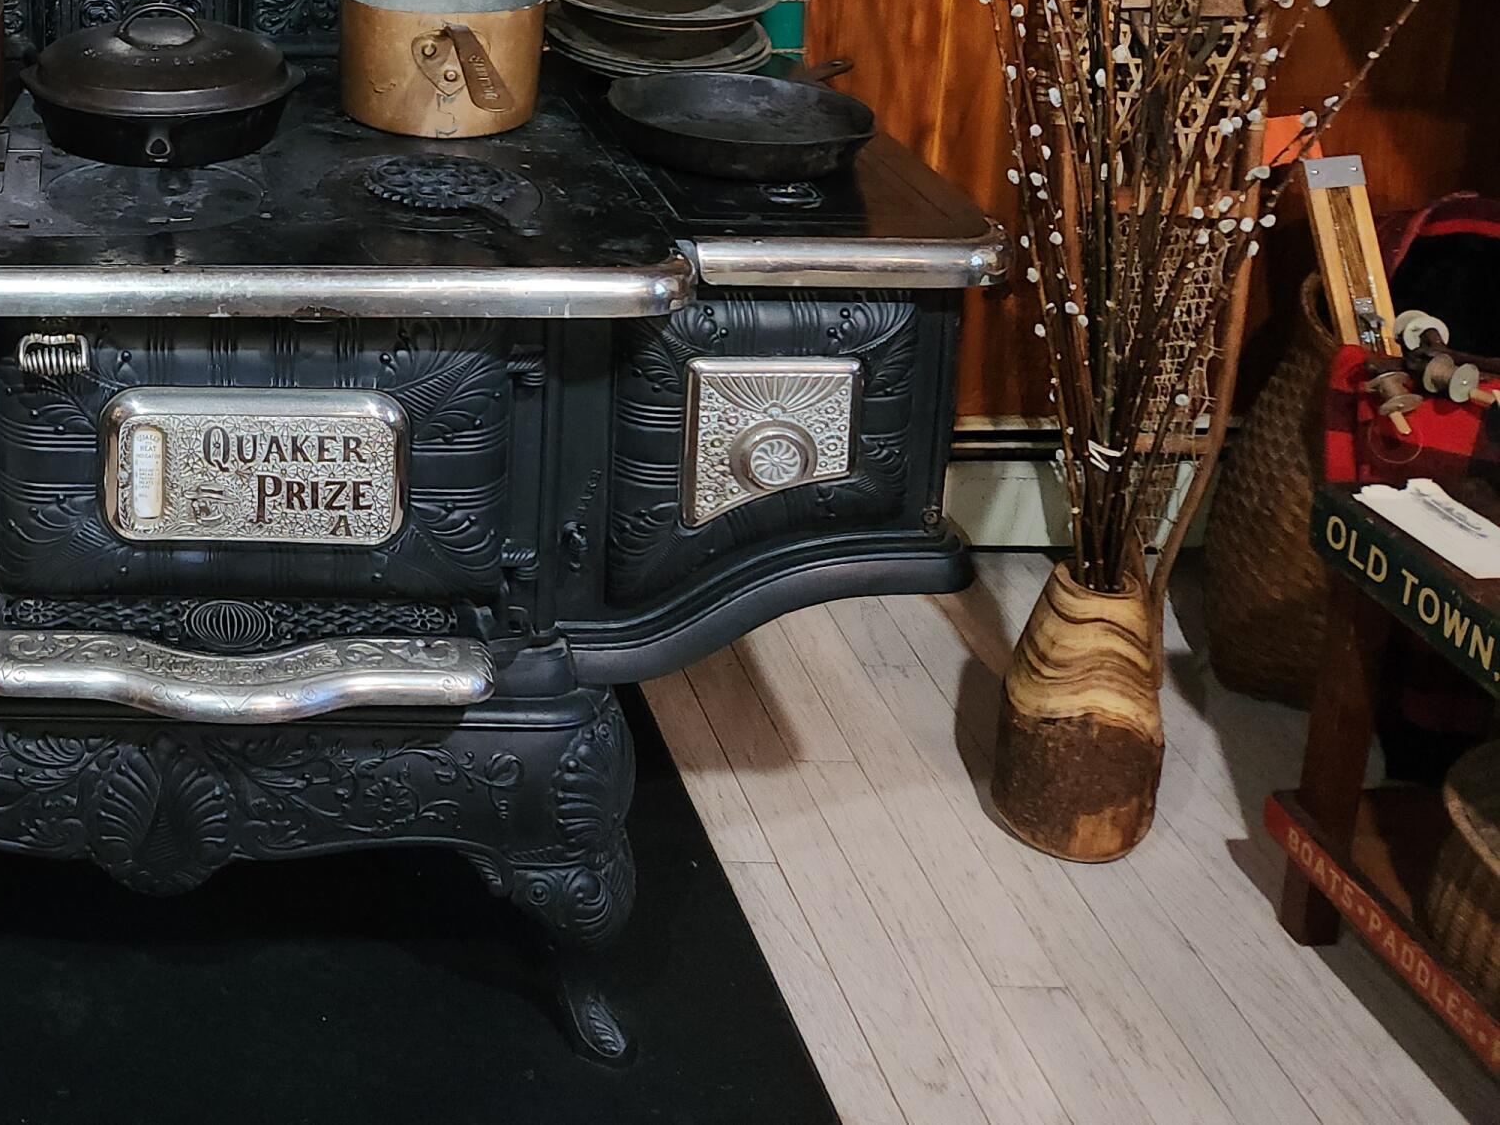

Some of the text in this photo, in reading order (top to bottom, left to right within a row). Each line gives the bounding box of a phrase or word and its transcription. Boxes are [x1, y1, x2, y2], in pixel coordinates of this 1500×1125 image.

[203, 426, 368, 472] QUAKER
[251, 474, 373, 525] PRIZE
[329, 515, 352, 537] A
[1326, 516, 1388, 583] OLD
[1288, 828, 1476, 1036] BOATS PADDLES
